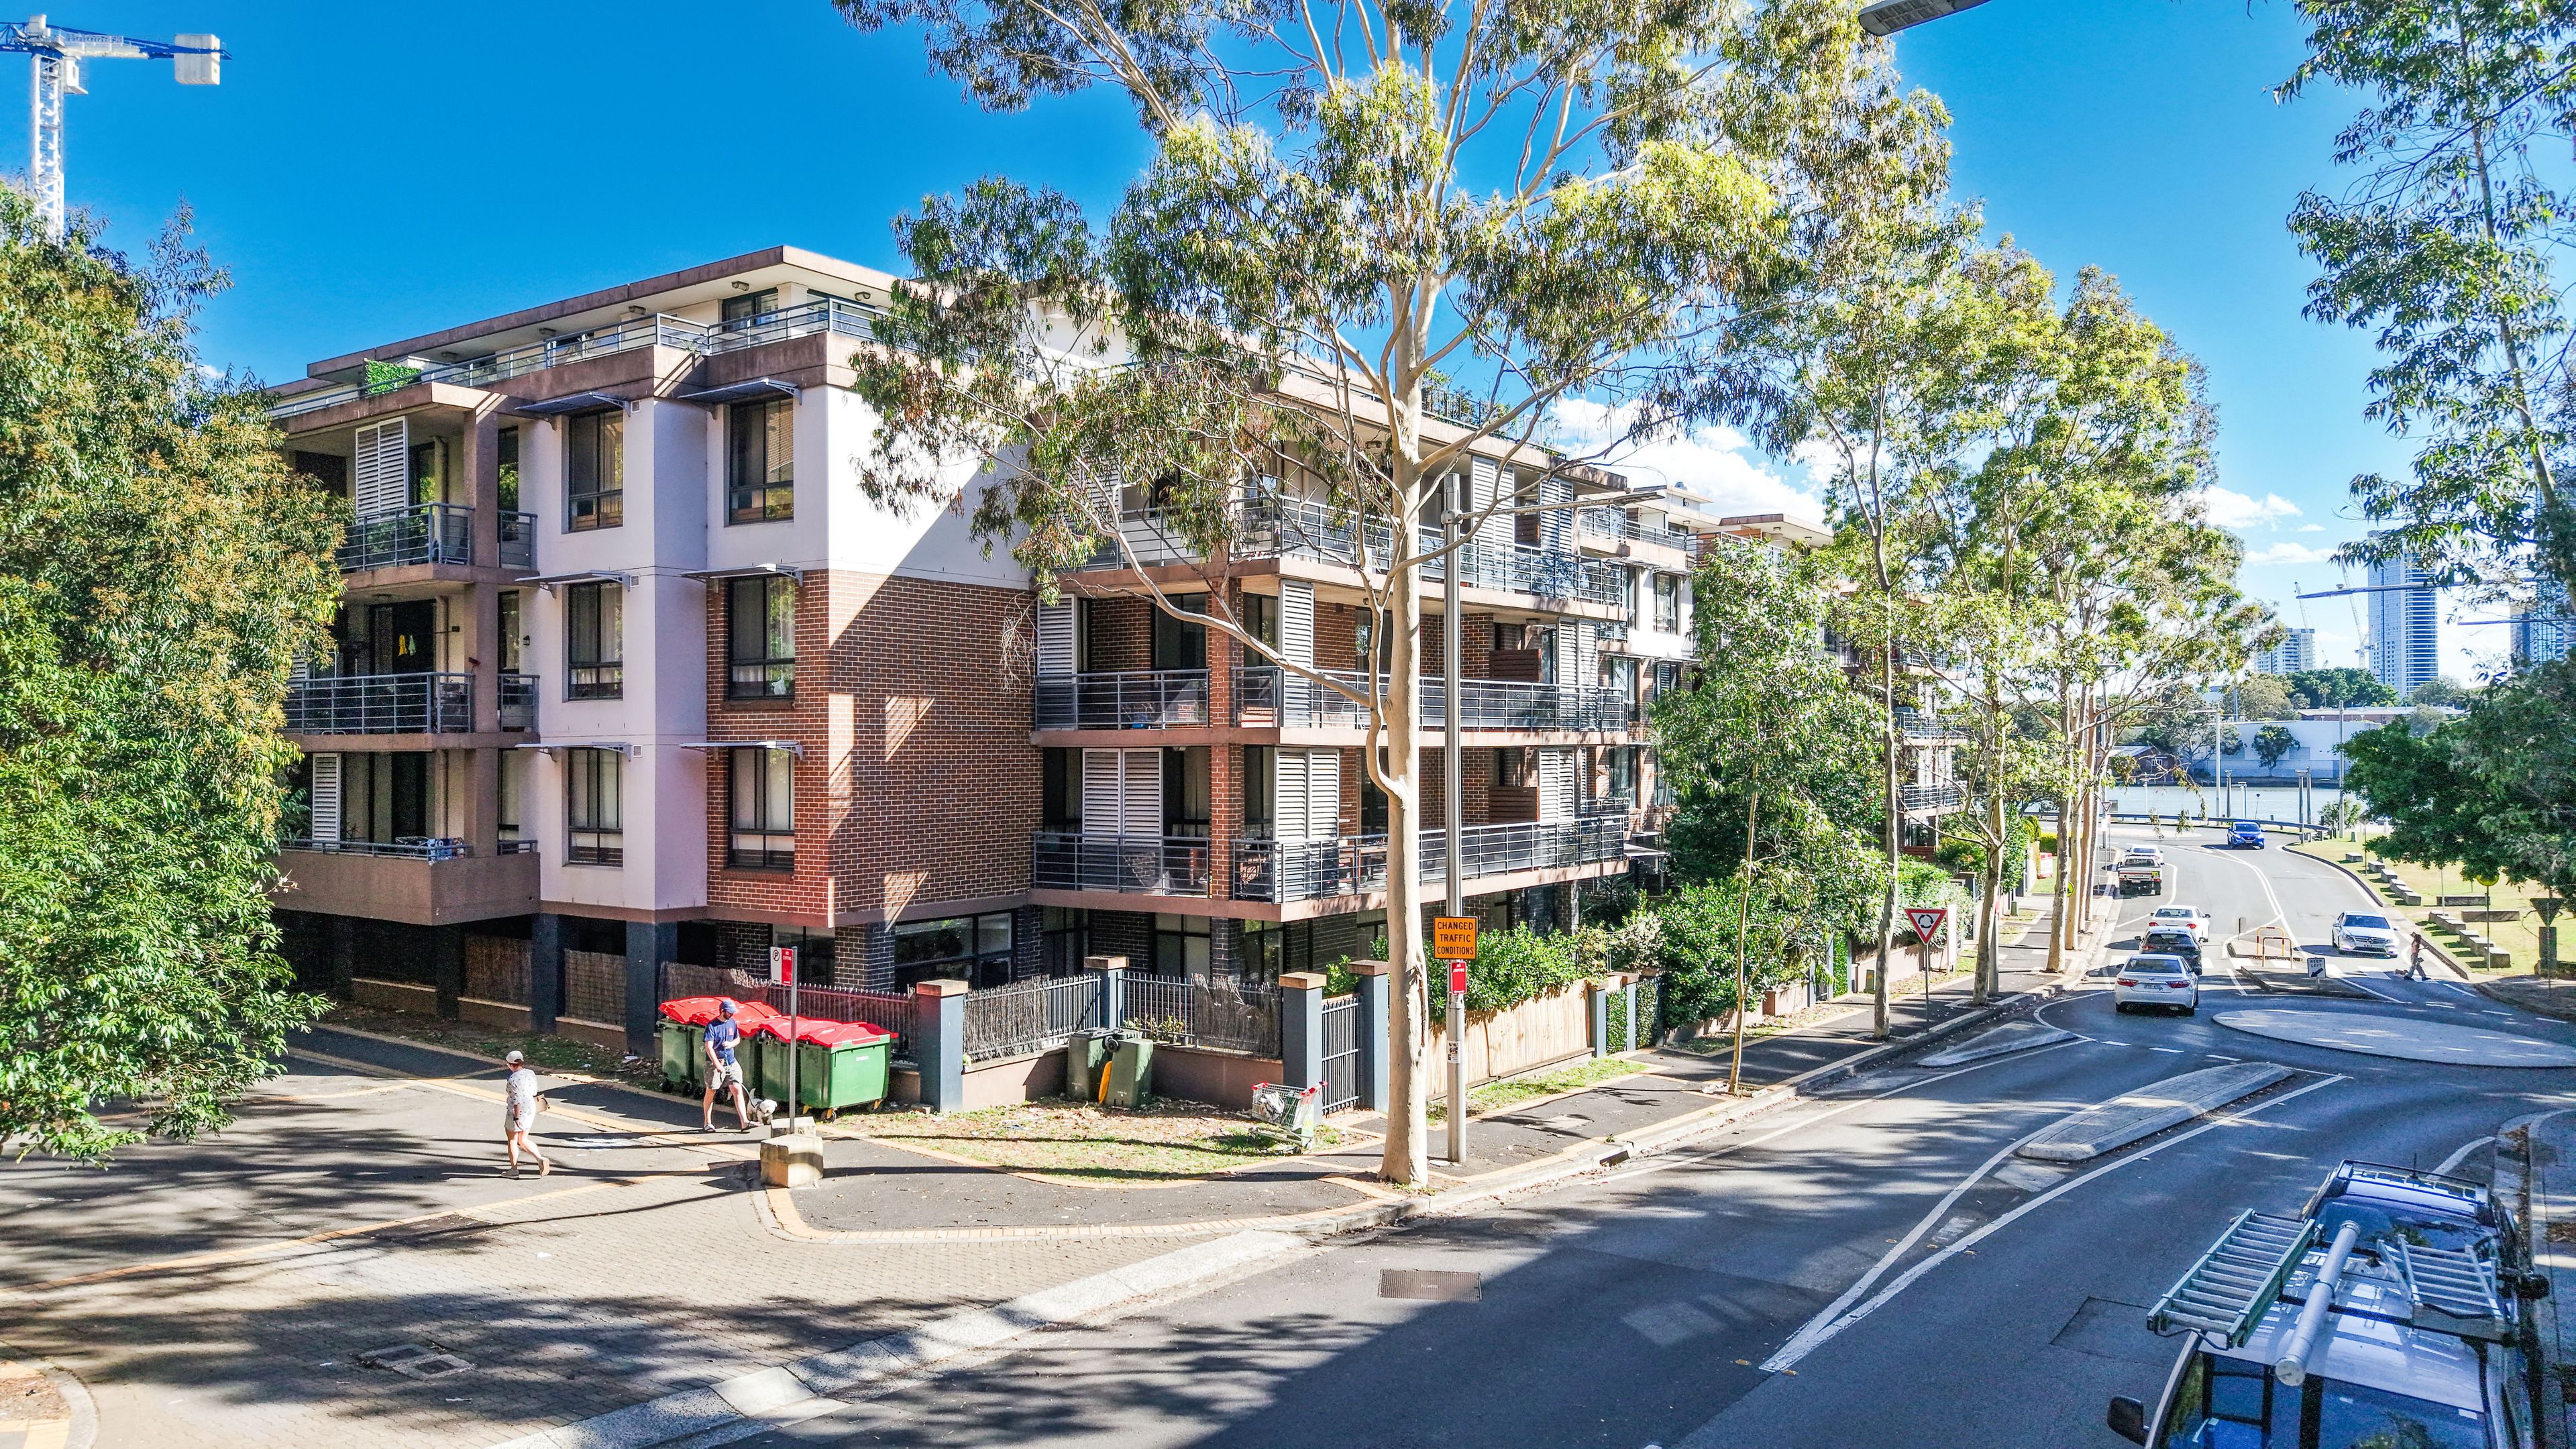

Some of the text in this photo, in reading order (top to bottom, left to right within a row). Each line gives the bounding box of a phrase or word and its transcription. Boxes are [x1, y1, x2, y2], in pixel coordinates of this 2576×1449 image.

[1438, 921, 1473, 930] CHANGED
[1440, 934, 1471, 943] TRAFFIC
[1437, 946, 1474, 955] CONDITIONS
